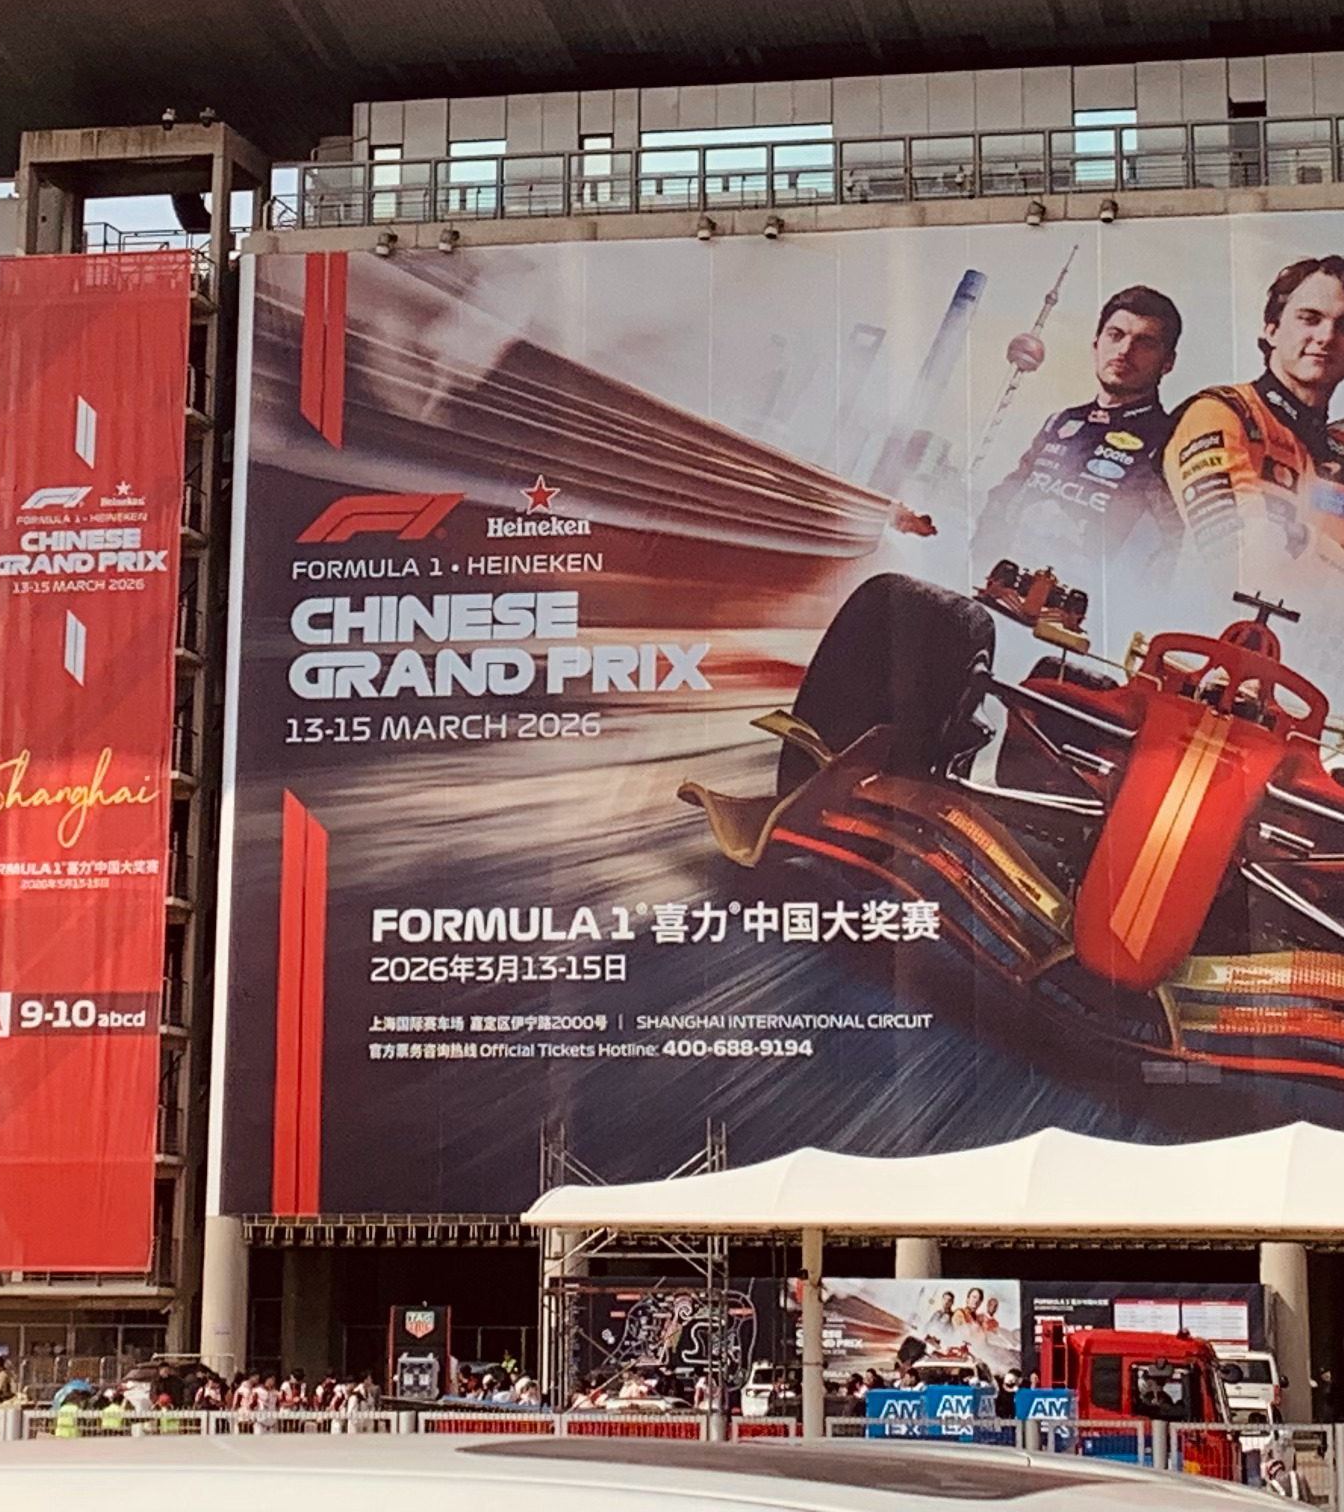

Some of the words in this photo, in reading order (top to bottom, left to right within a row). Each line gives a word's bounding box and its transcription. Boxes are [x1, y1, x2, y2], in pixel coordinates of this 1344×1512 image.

[16, 514, 71, 525] FORMULA
[90, 512, 148, 523] HEINEKEN
[487, 516, 591, 539] Heineken
[20, 527, 141, 552] CHINESE
[98, 550, 168, 573] PRIX
[292, 556, 419, 580] FORMULA
[429, 557, 443, 576] 1
[467, 553, 603, 575] HEINEKEN
[12, 581, 50, 594] 13-15
[52, 579, 105, 593] MARCH
[108, 578, 145, 591] 2026
[291, 591, 578, 645] CHINESE
[288, 648, 537, 699] GRAND
[547, 643, 712, 694] PRIX
[285, 717, 371, 744] 13-15
[381, 714, 507, 741] MARCH
[518, 712, 601, 738] 2026
[372, 907, 601, 943] FORMULA
[370, 954, 627, 984] 2026年3月13-15日
[20, 999, 96, 1029] 9-10
[97, 1010, 146, 1028] abcd
[369, 1016, 463, 1032] 上海国际赛车场
[470, 1014, 607, 1032] 嘉定区伊宁路2000号
[636, 1015, 725, 1030] SHANGHAI
[728, 1014, 865, 1029] INTERNATIONAL
[867, 1013, 933, 1029] CIRCUIT
[369, 1043, 477, 1059] 官方票务咨询热线
[480, 1043, 535, 1057] Official
[538, 1043, 595, 1057] Tickets
[662, 1040, 813, 1057] 400-688-9194
